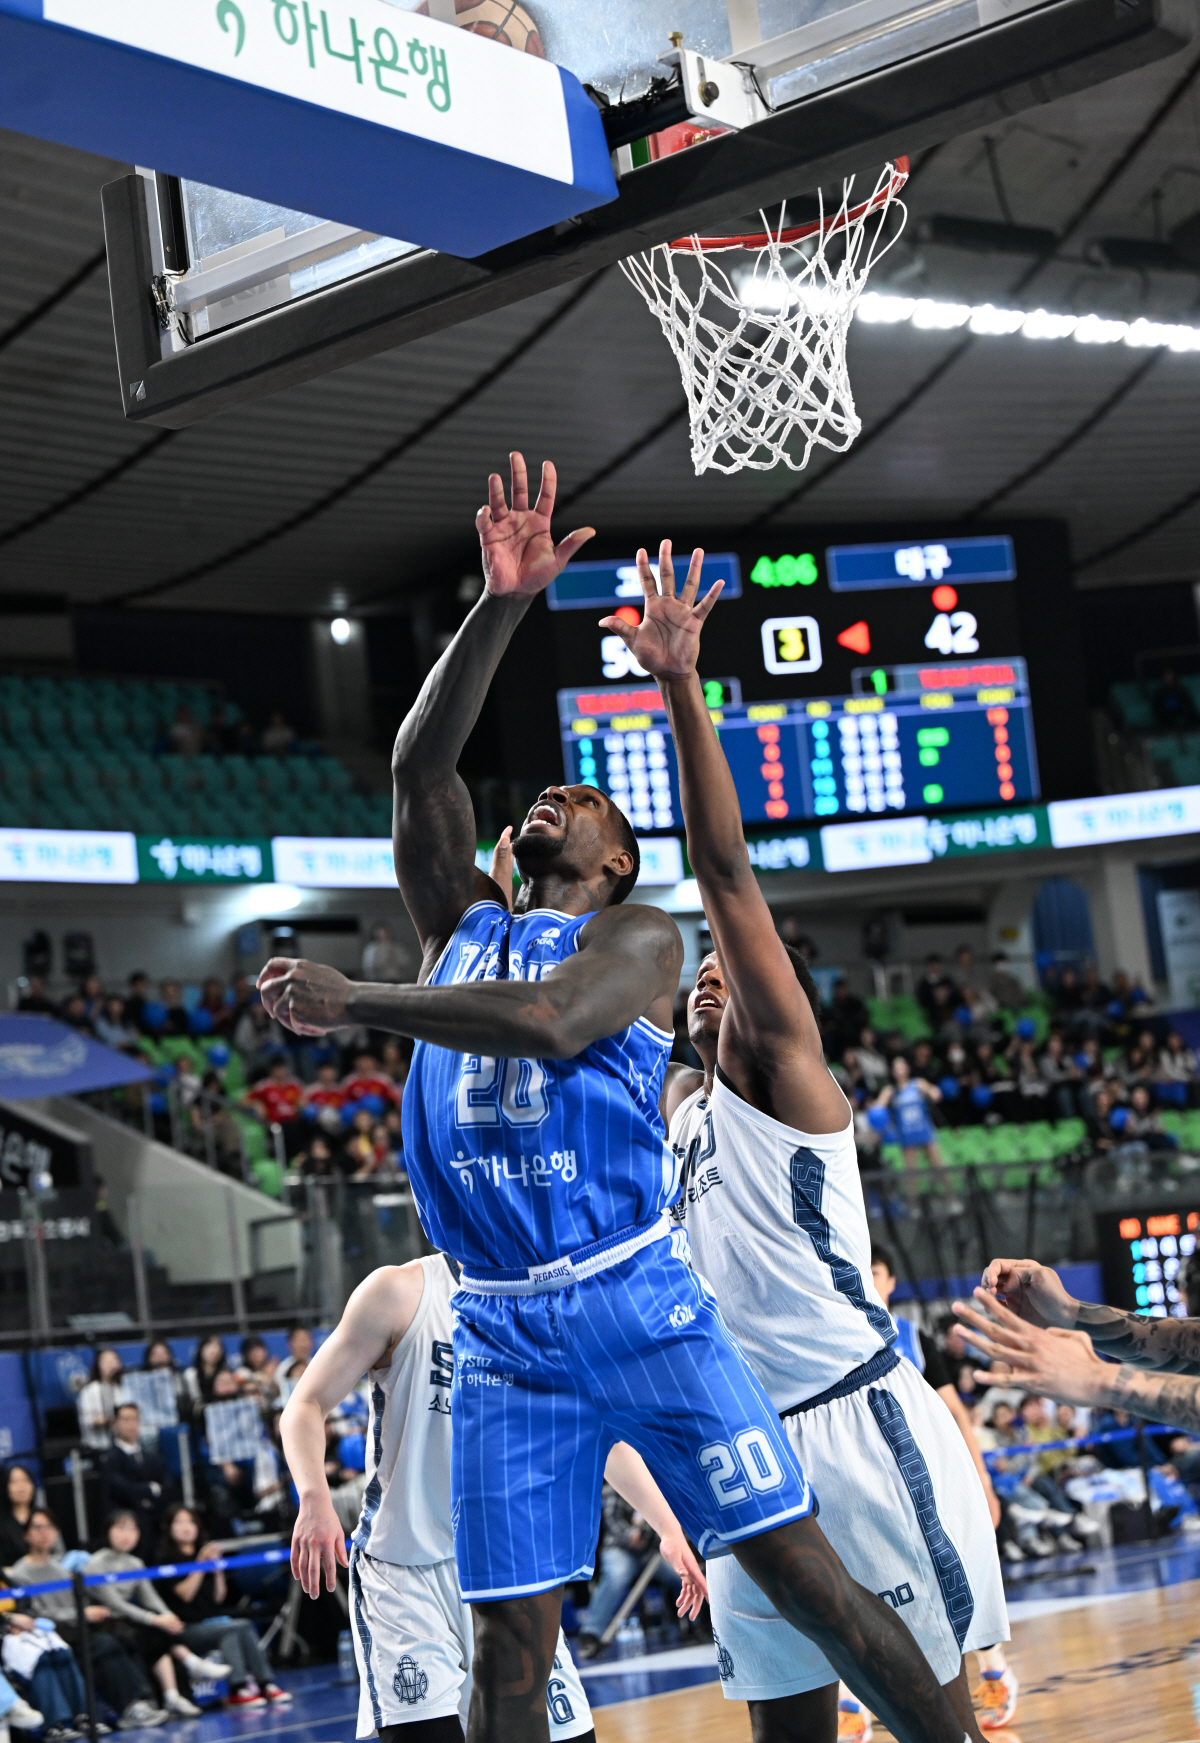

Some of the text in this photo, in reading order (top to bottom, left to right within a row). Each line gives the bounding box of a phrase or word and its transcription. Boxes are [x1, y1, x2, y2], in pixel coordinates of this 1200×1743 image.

[271, 0, 451, 112] 하나은행
[924, 611, 979, 655] 42
[454, 1053, 550, 1129] 20
[477, 1150, 577, 1187] 하나은행
[533, 1265, 570, 1285] PEGASUS
[466, 1373, 515, 1388] 하나은행
[697, 1425, 786, 1510] 20
